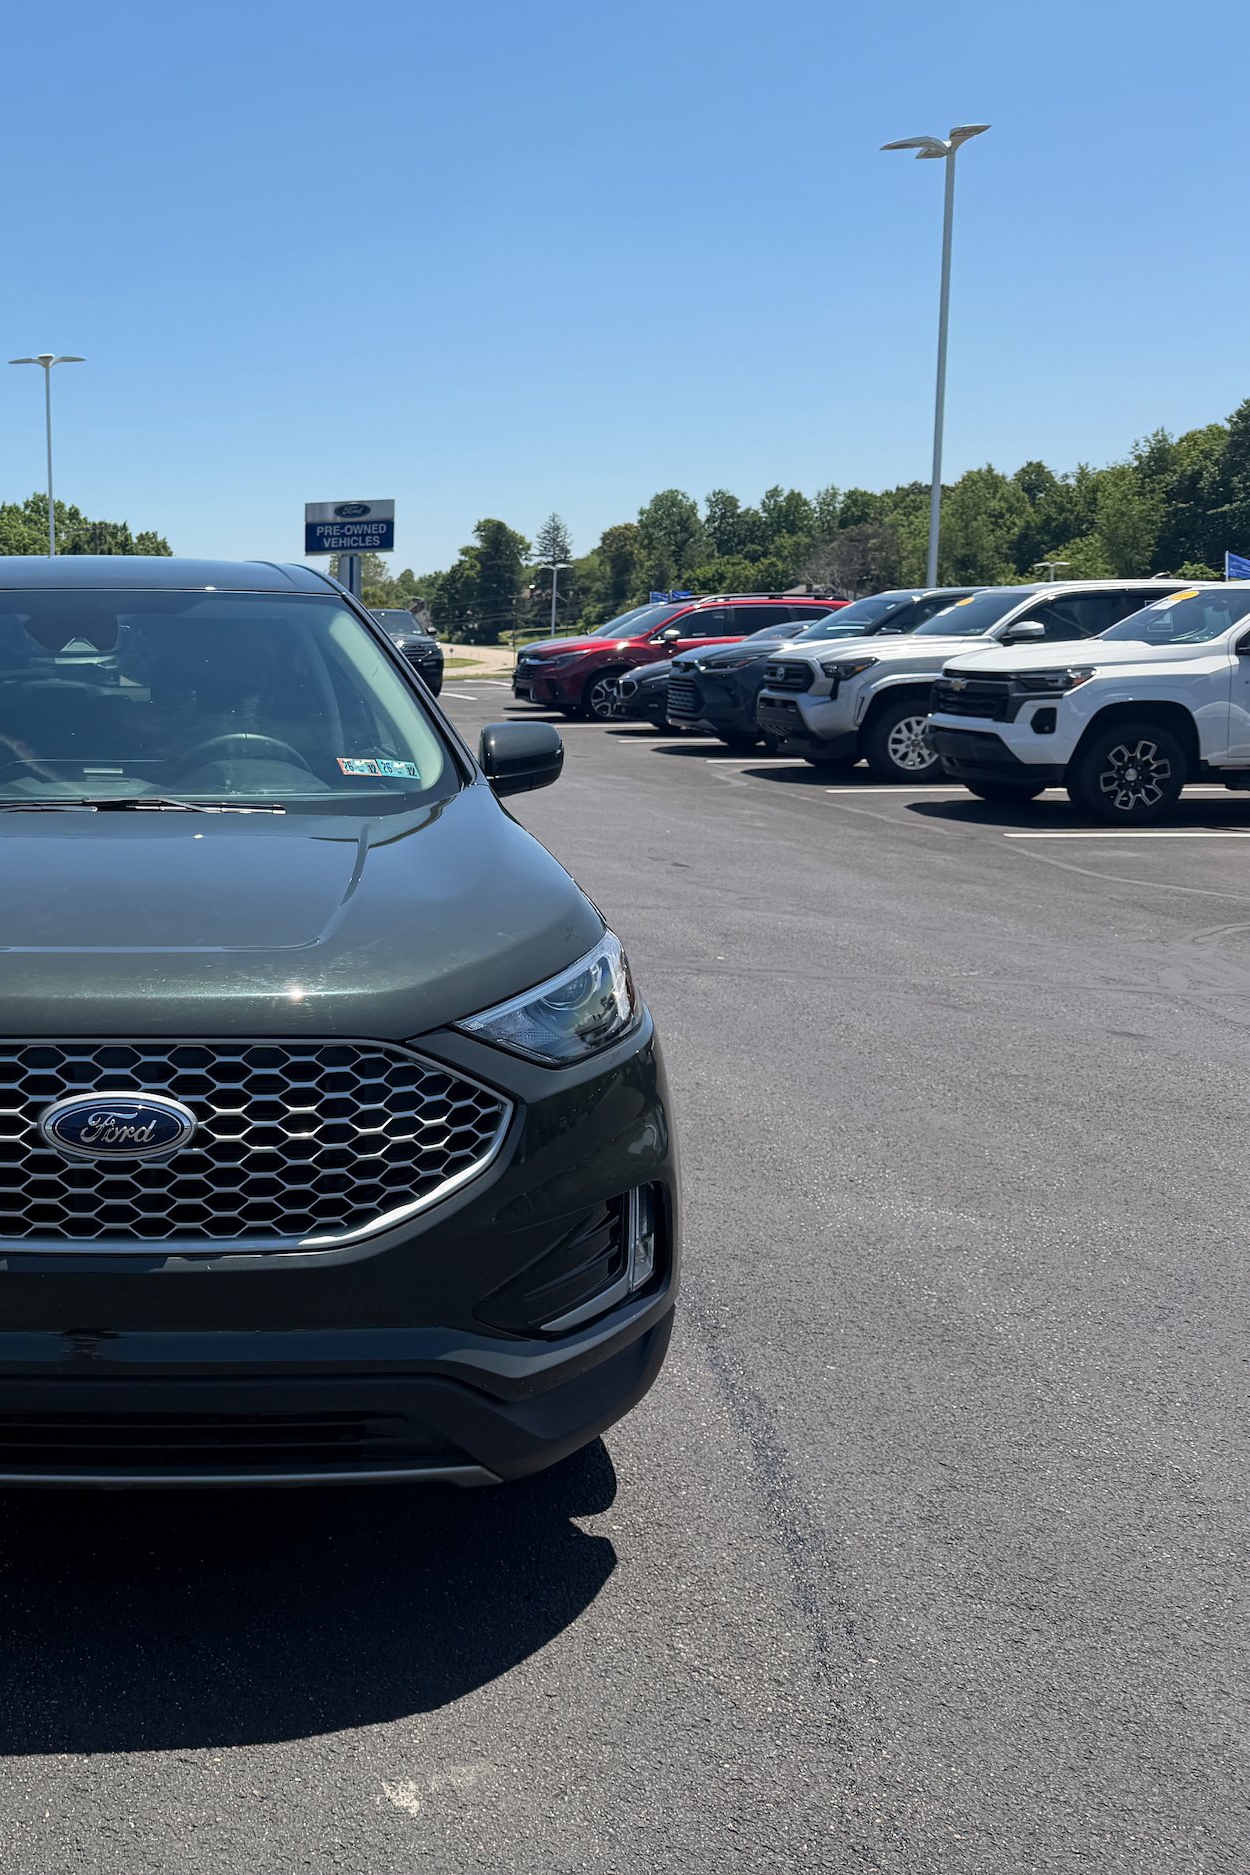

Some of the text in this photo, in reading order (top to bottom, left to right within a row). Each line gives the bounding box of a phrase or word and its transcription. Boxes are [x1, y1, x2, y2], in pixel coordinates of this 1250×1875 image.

[316, 523, 387, 536] PRE-OWNED
[323, 535, 381, 548] VEHICLES
[367, 764, 379, 774] 12
[381, 761, 393, 773] 26
[80, 1111, 157, 1143] Ford
